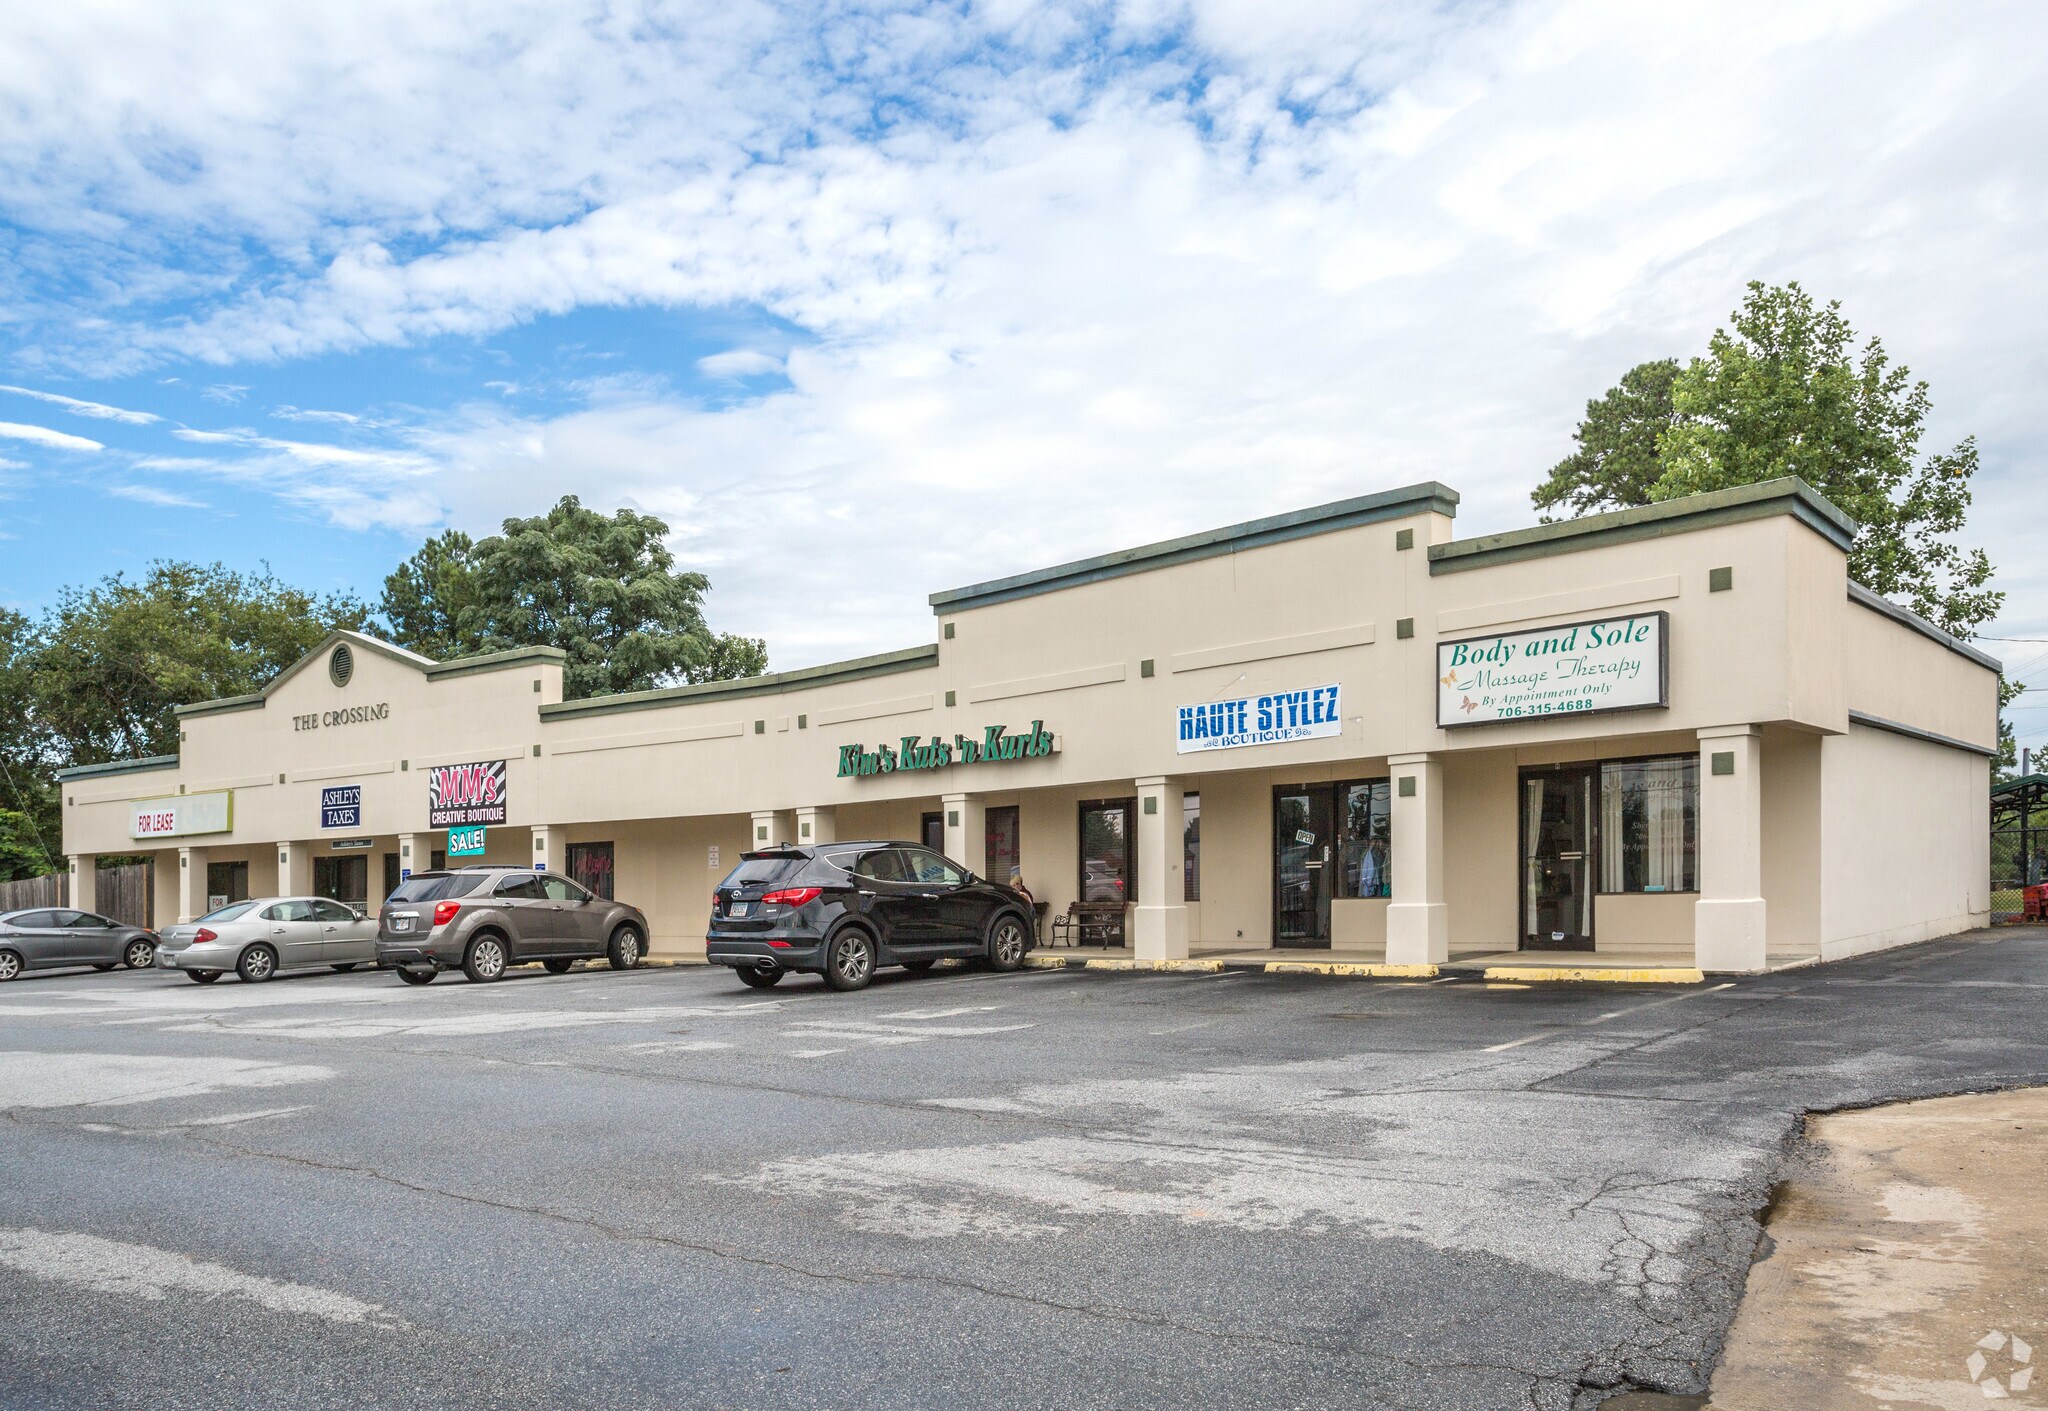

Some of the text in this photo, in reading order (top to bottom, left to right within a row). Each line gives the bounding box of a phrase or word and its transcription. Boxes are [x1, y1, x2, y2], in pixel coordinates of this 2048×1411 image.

[1450, 619, 1650, 667] Body and Sole
[1456, 655, 1641, 691] Massage Therapy
[1482, 682, 1612, 707] By Appointment Only
[1497, 698, 1593, 718] 706-315-4688
[292, 702, 390, 731] THE CROSSING
[1179, 686, 1339, 741] HAUTE STYLEZ
[837, 743, 897, 778] Kim's
[898, 736, 953, 771] Kuts
[980, 719, 1055, 762] Kurls
[1221, 728, 1293, 747] BOUTIQUE
[438, 766, 498, 805] MM's
[322, 788, 360, 825] ASHLEY'S TAXES
[432, 807, 504, 824] CREATIVE BOUTIQUE
[138, 813, 174, 832] FOR LEASE
[451, 829, 485, 853] SALE!
[1297, 831, 1315, 844] OPEN
